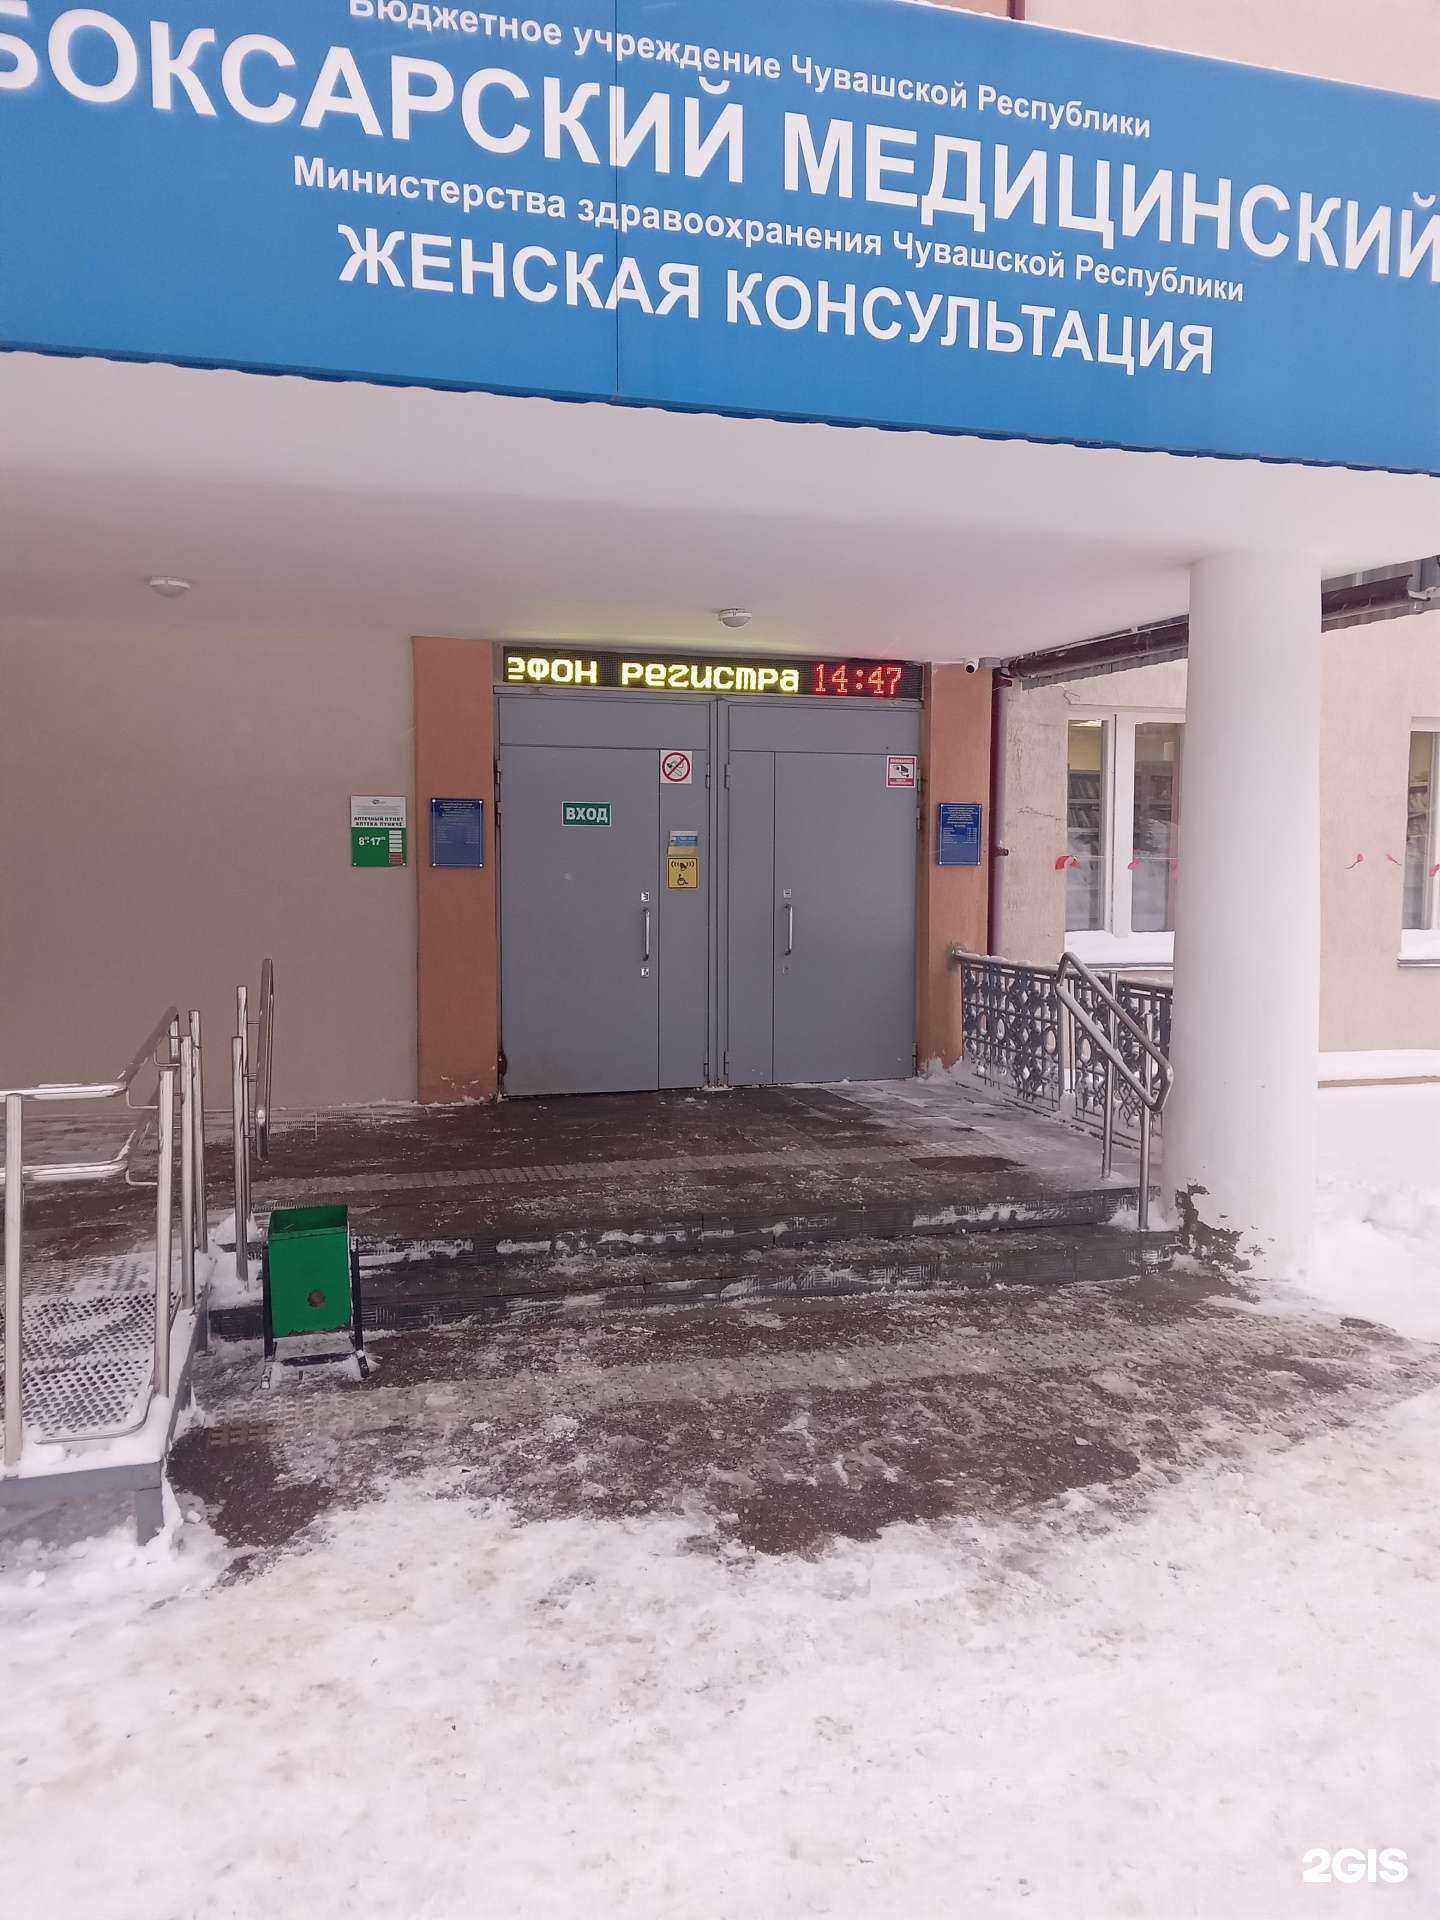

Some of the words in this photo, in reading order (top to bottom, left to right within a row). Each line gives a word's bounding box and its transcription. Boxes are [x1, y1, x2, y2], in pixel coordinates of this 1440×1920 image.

[350, 0, 562, 45] Бюджетное
[573, 24, 781, 80] учреждение
[792, 53, 967, 110] Чувашской
[978, 85, 1151, 139] Республики
[294, 155, 566, 219] Министерства
[577, 197, 882, 256] здравоохранения
[893, 233, 1064, 279] Чувашской
[1076, 254, 1244, 302] Республики
[783, 110, 1440, 284] МЕДИЦИНСКИЙ
[337, 224, 700, 319] ЖЕНСКАЯ
[726, 269, 1214, 376] КОНСУЛЬТАЦИЯ
[816, 664, 902, 695] 14:47
[565, 807, 608, 823] ВХОД
